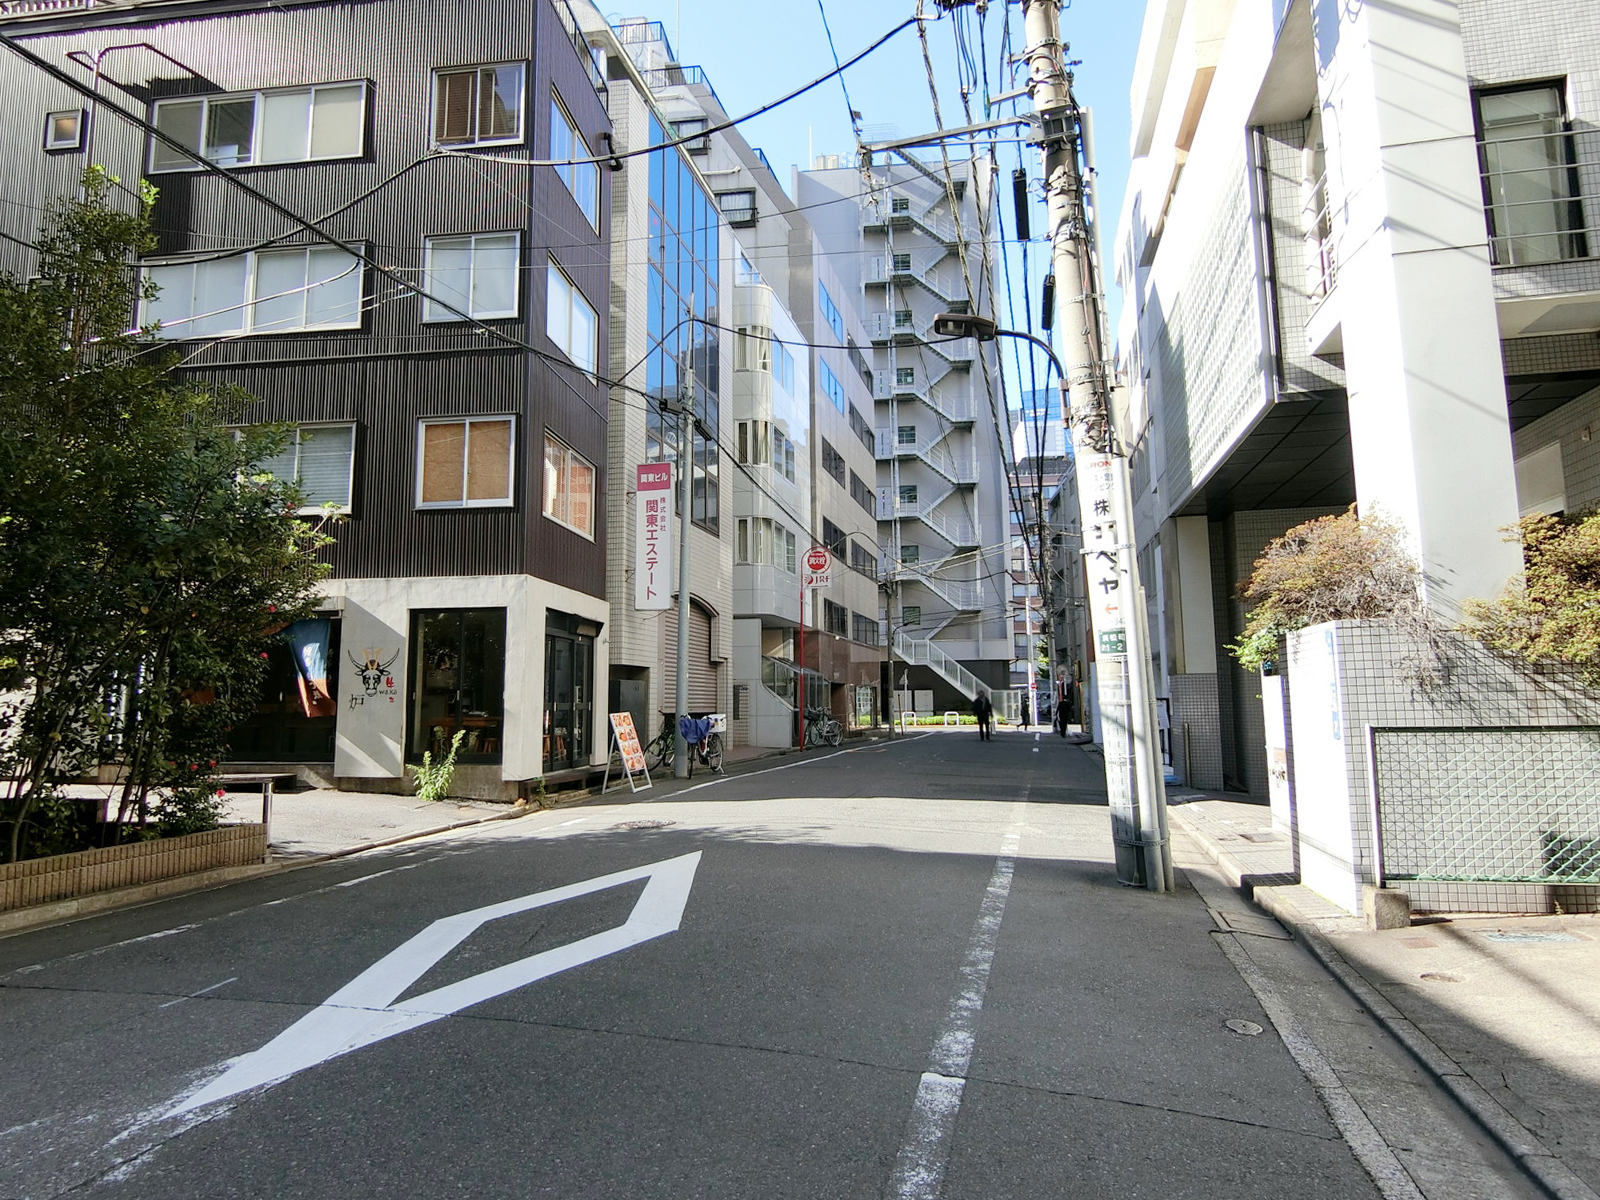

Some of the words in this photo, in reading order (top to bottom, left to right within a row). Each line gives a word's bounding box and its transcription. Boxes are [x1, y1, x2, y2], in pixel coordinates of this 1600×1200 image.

[640, 473, 668, 483] 関東ビル
[645, 499, 659, 600] 関東エステート
[809, 556, 826, 565] 消火栓
